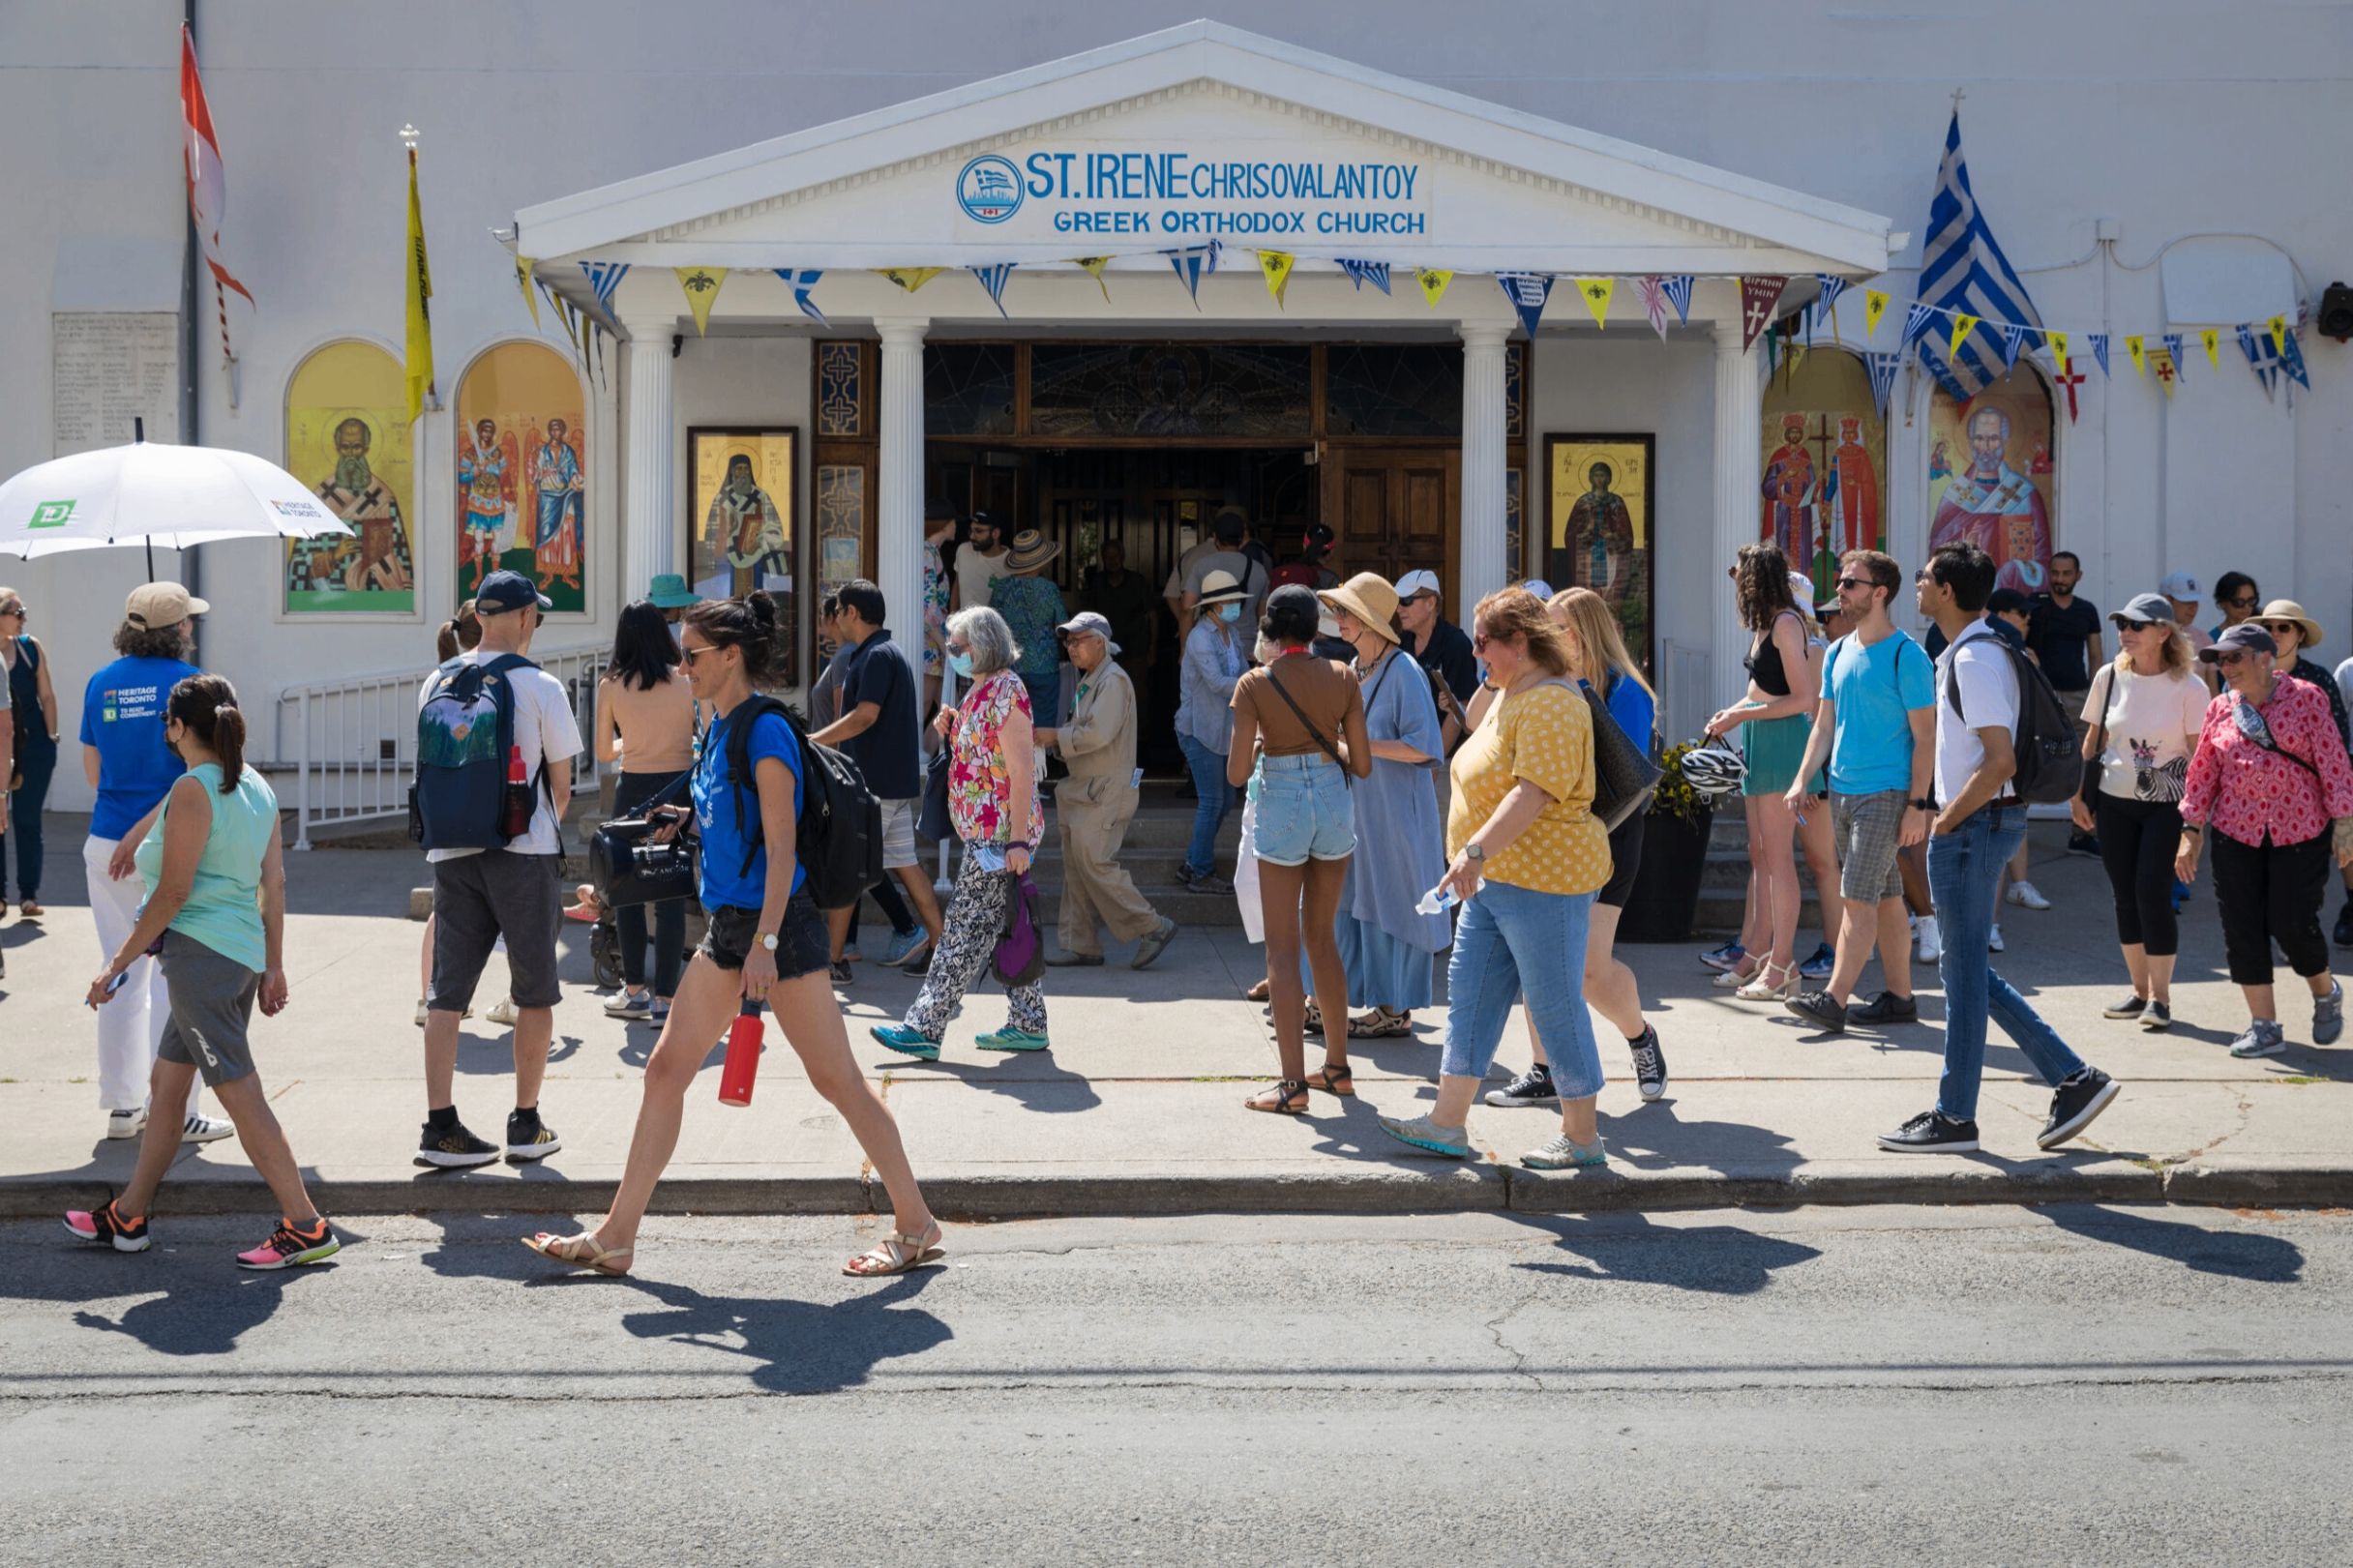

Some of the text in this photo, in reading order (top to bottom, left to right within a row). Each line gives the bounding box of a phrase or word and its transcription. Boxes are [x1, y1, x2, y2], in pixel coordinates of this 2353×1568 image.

[1190, 163, 1418, 200] CHRISOVALANTOY
[1053, 210, 1425, 234] GREEK ORTHODOX CHURCH
[40, 505, 69, 522] TD
[118, 686, 157, 695] HERITAGE
[118, 695, 157, 704] TORONTO
